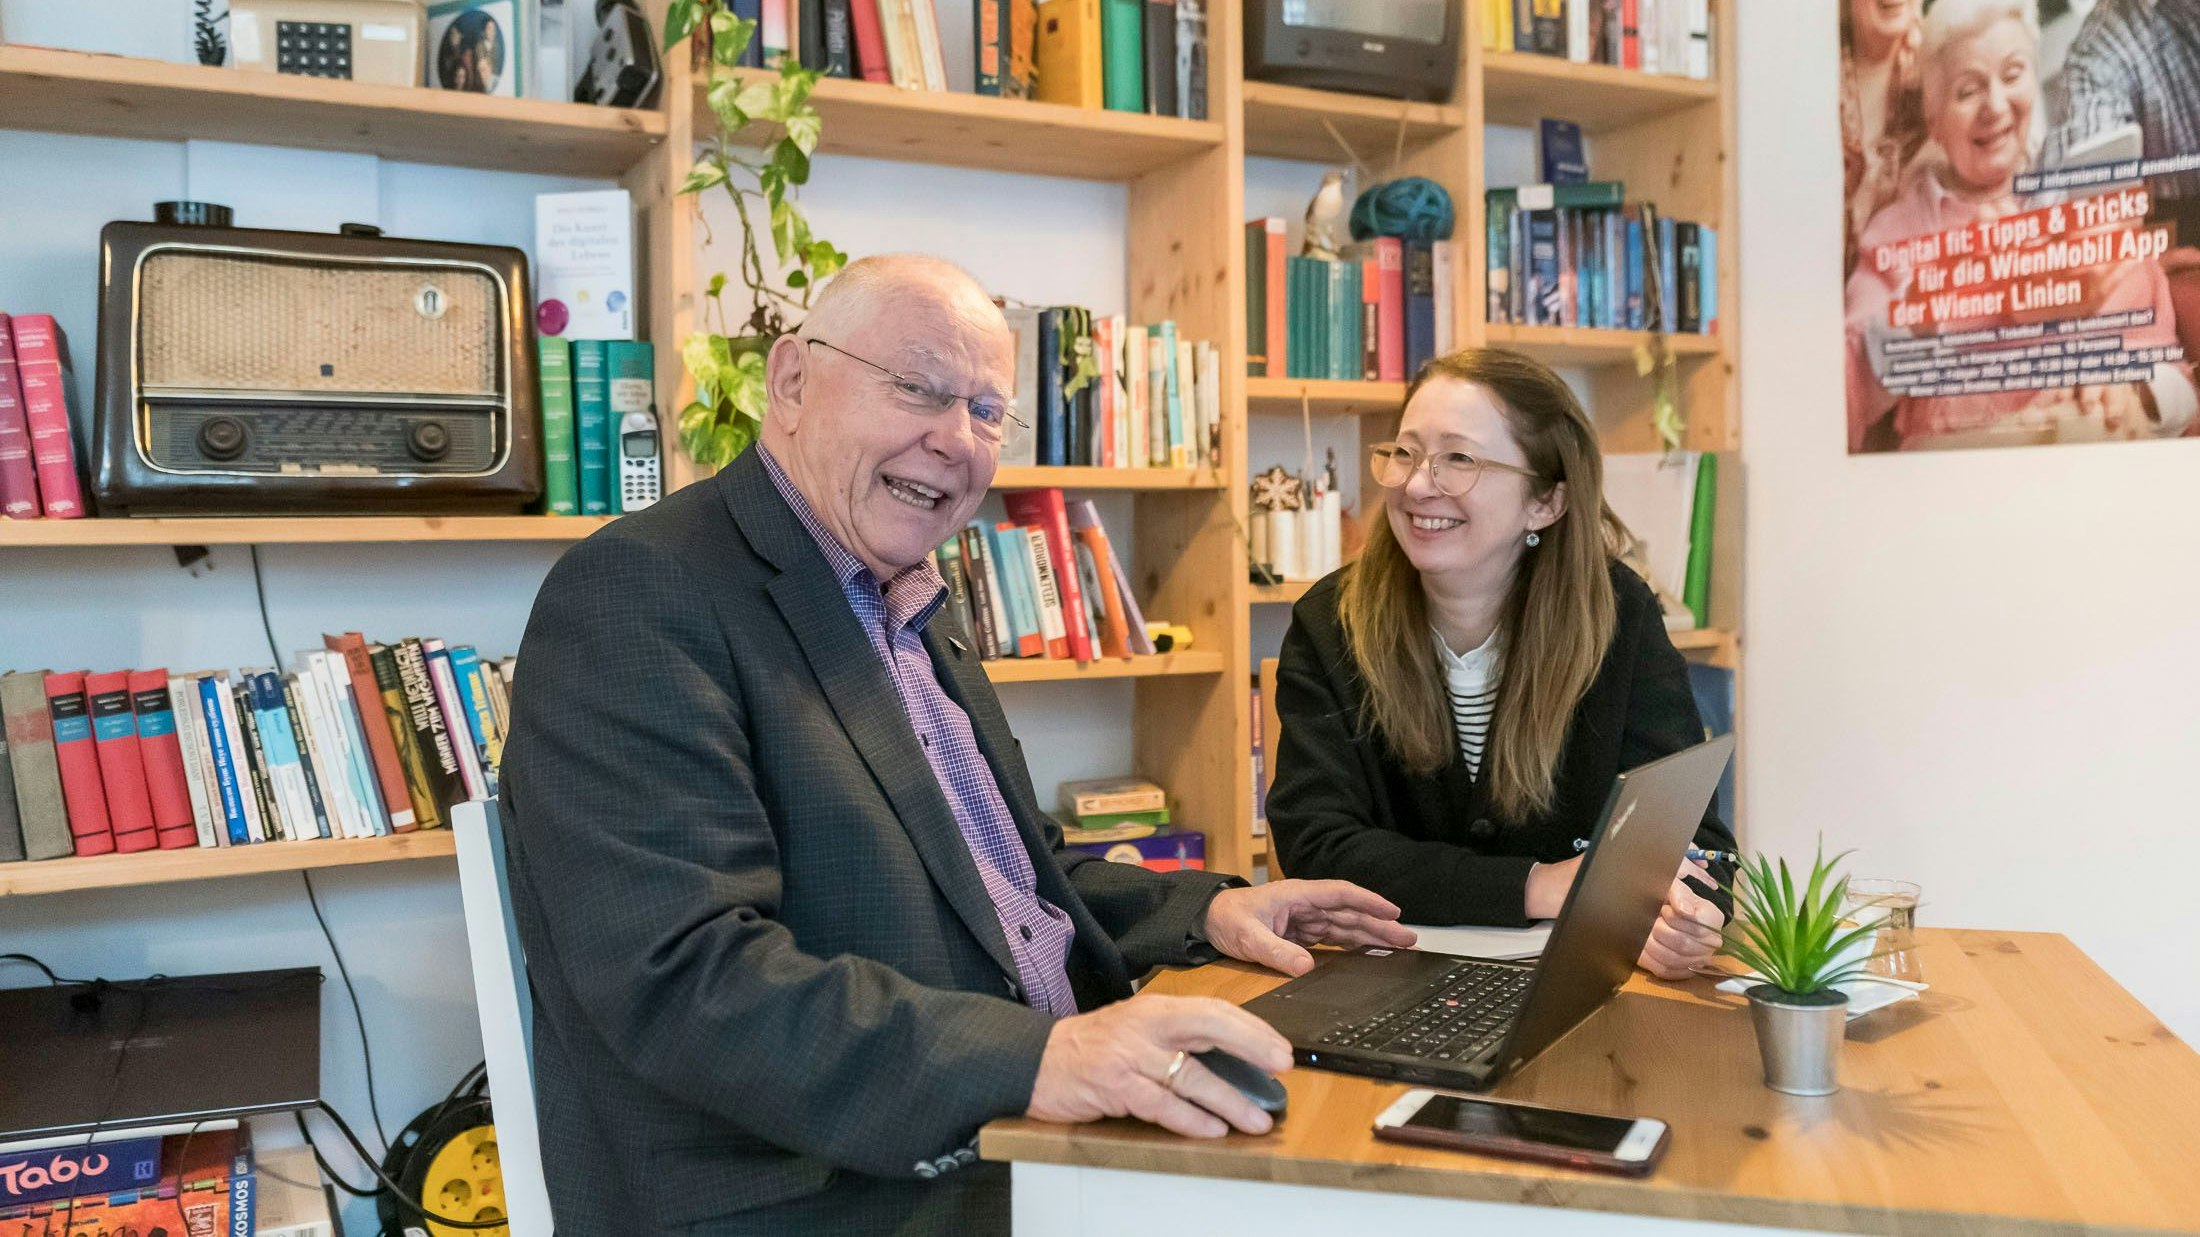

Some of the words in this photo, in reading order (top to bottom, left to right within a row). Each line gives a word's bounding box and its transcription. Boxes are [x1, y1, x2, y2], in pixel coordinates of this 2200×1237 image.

[1876, 236, 1940, 272] Digital
[1946, 232, 1974, 257] fit:
[1979, 214, 2041, 249] Tipps
[2048, 207, 2066, 234] &
[2073, 189, 2150, 228] Tricks
[1917, 267, 1948, 292] für
[1953, 259, 1985, 287] die
[1990, 232, 2112, 280] WienMobil
[2119, 228, 2169, 263] App
[1892, 300, 1927, 328] der
[1931, 287, 2005, 322] Wiener
[2011, 278, 2081, 312] Linien
[410, 703, 430, 732] WILLI
[428, 706, 446, 733] ZUM
[0, 1153, 109, 1195] Tabu
[234, 1179, 249, 1237] KOSMOS
